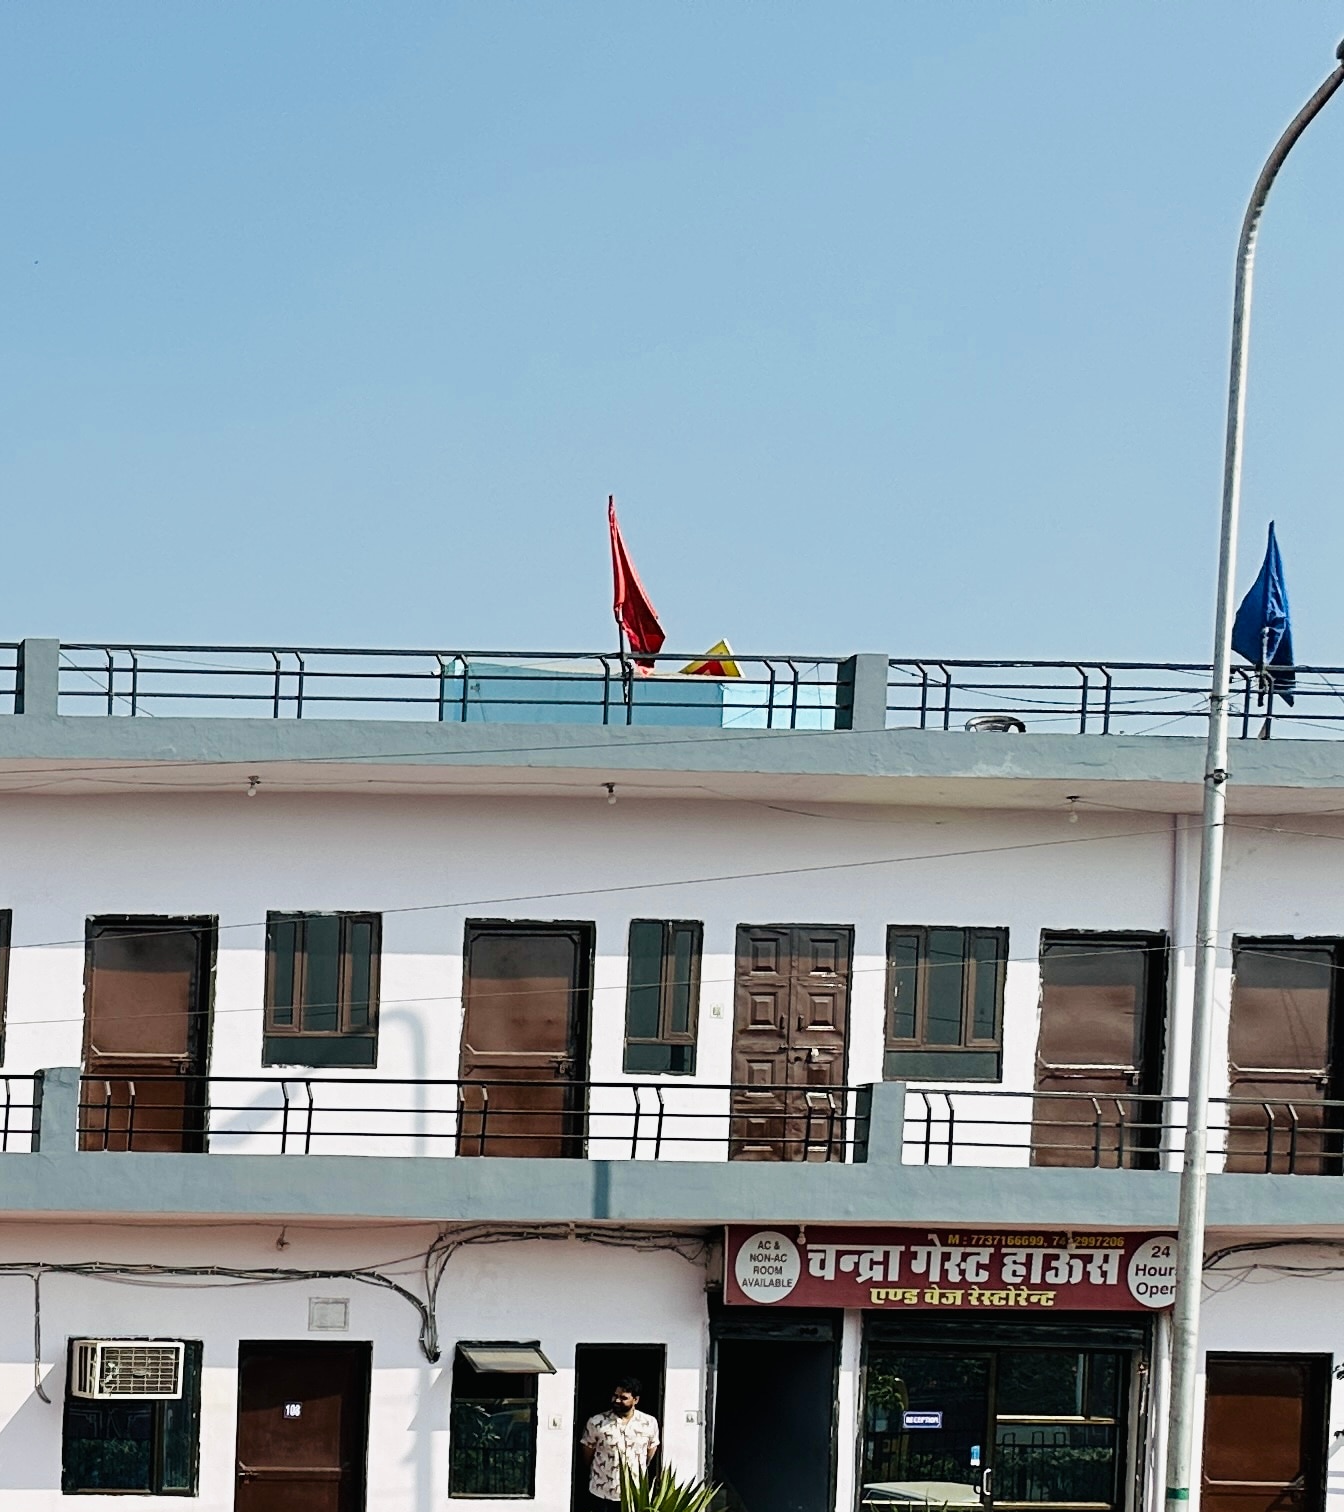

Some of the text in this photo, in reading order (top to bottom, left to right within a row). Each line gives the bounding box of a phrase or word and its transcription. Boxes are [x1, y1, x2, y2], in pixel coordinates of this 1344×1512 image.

[758, 1240, 772, 1250] AC
[1151, 1245, 1171, 1258] 24
[749, 1253, 788, 1263] NON-AC
[806, 1234, 1125, 1285] चन्द्रा गेस्ट हाऊस
[753, 1265, 783, 1275] ROOM
[1135, 1263, 1177, 1277] Hour
[742, 1278, 793, 1288] AVAILABLE
[870, 1284, 1057, 1306] एण्ड वेज रेस्टोरेन्ट
